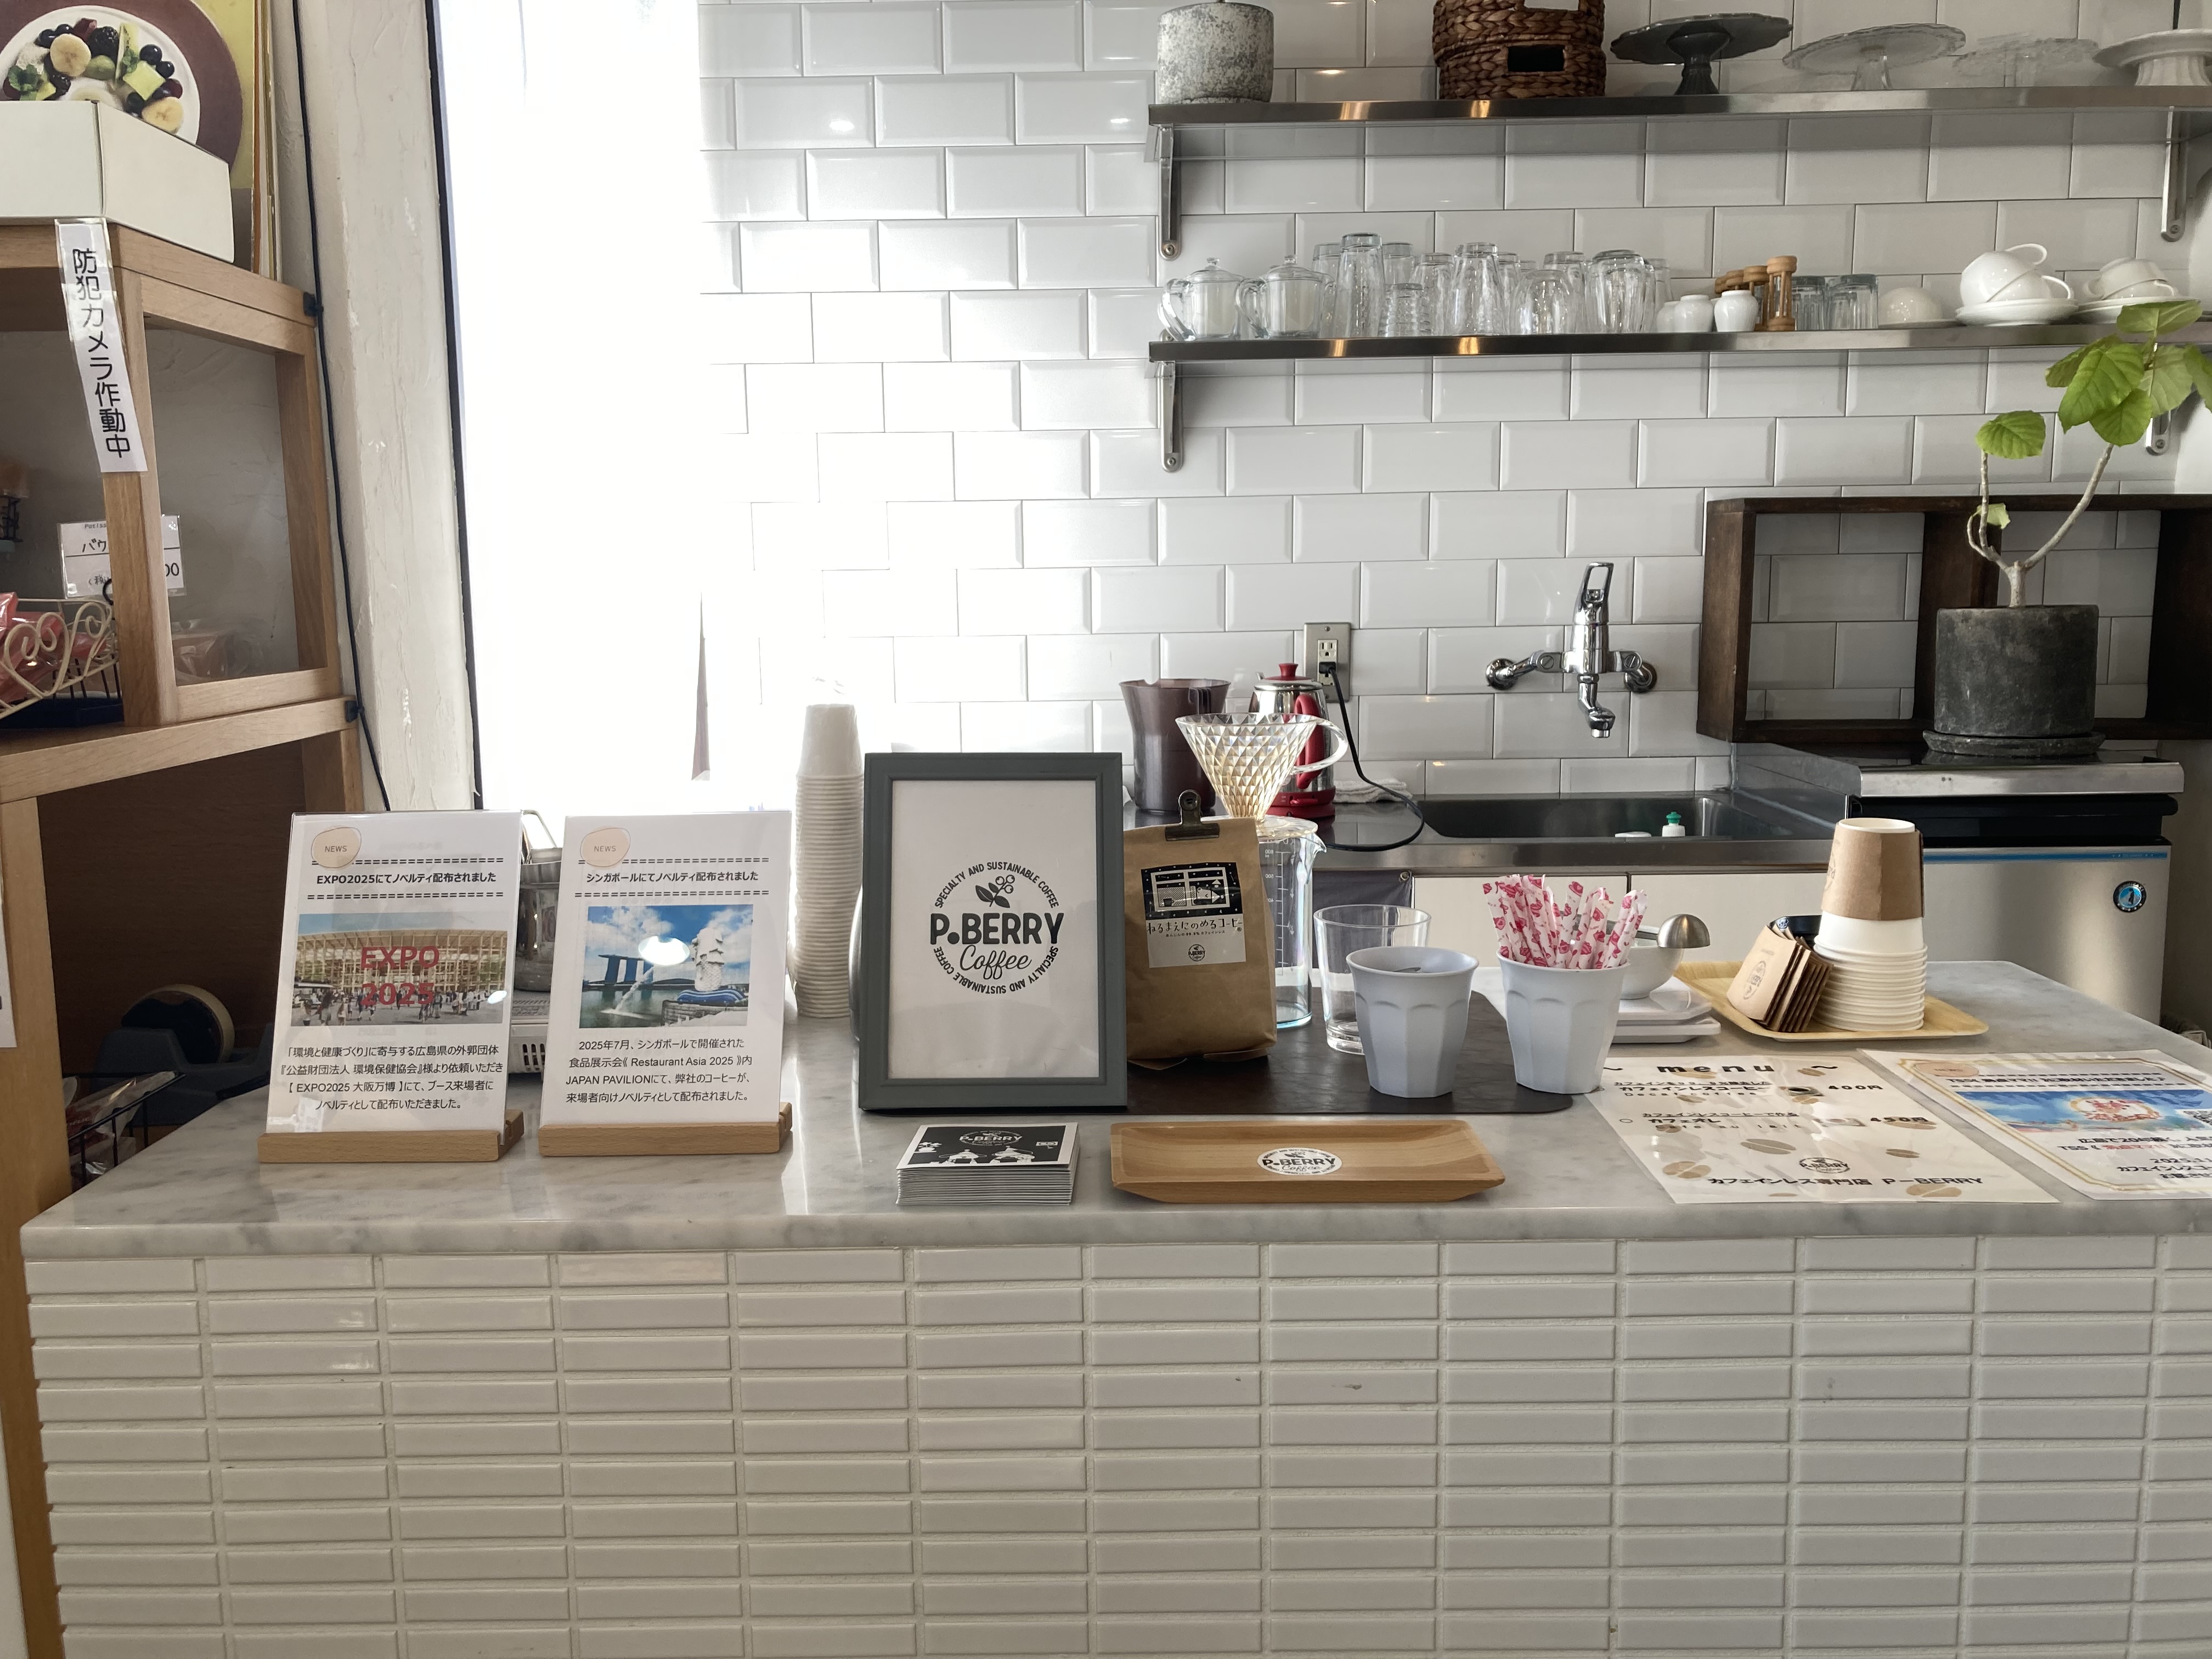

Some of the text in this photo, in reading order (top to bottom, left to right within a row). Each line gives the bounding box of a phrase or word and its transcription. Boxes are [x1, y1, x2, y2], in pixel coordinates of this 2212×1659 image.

[72, 247, 131, 459] 防犯カメラ作動中
[324, 845, 348, 853] NEWS
[316, 872, 496, 885] EXPO2025にてノベルティ配布されました
[586, 871, 759, 884] シンガポールにてノベルティ配布されました
[934, 861, 1059, 909] SPECIALTY AND SUSTAINABLE COFFEE
[929, 912, 1065, 945] P.BERRY
[1147, 918, 1243, 935] ねるまえにのめるコーヒー
[360, 945, 441, 970] EXPO
[959, 944, 1032, 980] Coffee
[933, 945, 1059, 994] SPECIALTY AND SUSTAINABLE COFFEE
[360, 982, 436, 1006] 2025
[288, 1044, 499, 1058] 「環境と健康づくり」に寄与する広島県の外郭団体
[578, 1037, 745, 1051] 2025年7月、シンガポールで開催された
[630, 1057, 684, 1068] Restaurant
[686, 1057, 707, 1066] Asia
[709, 1057, 734, 1066] 2025
[1656, 1065, 1775, 1073] menu
[566, 1075, 600, 1086] JAPAN
[315, 1098, 461, 1110] ノベルティとして配布いただきました。
[566, 1091, 748, 1104] 来場者向けノベルティとして配布されました。
